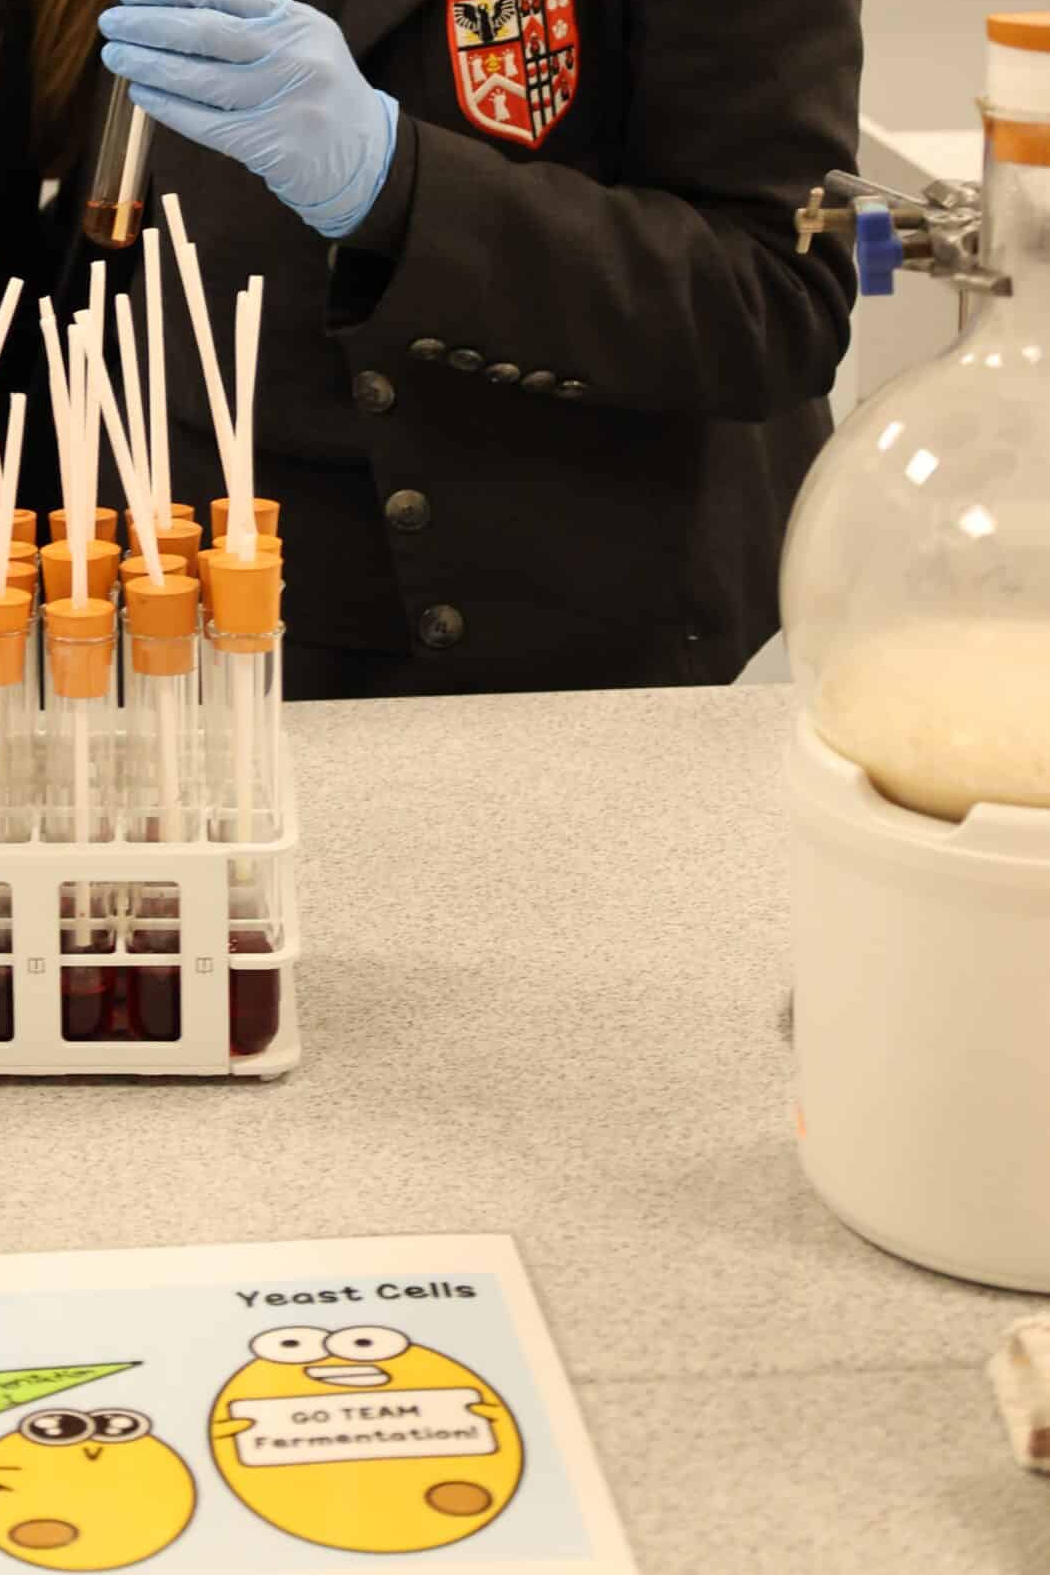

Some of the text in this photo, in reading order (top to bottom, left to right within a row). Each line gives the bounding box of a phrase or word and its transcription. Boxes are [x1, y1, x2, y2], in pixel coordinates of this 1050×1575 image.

[235, 1281, 477, 1308] Yeast Cells
[291, 1404, 422, 1425] GO TEAM
[254, 1426, 480, 1450] Fermentation!
